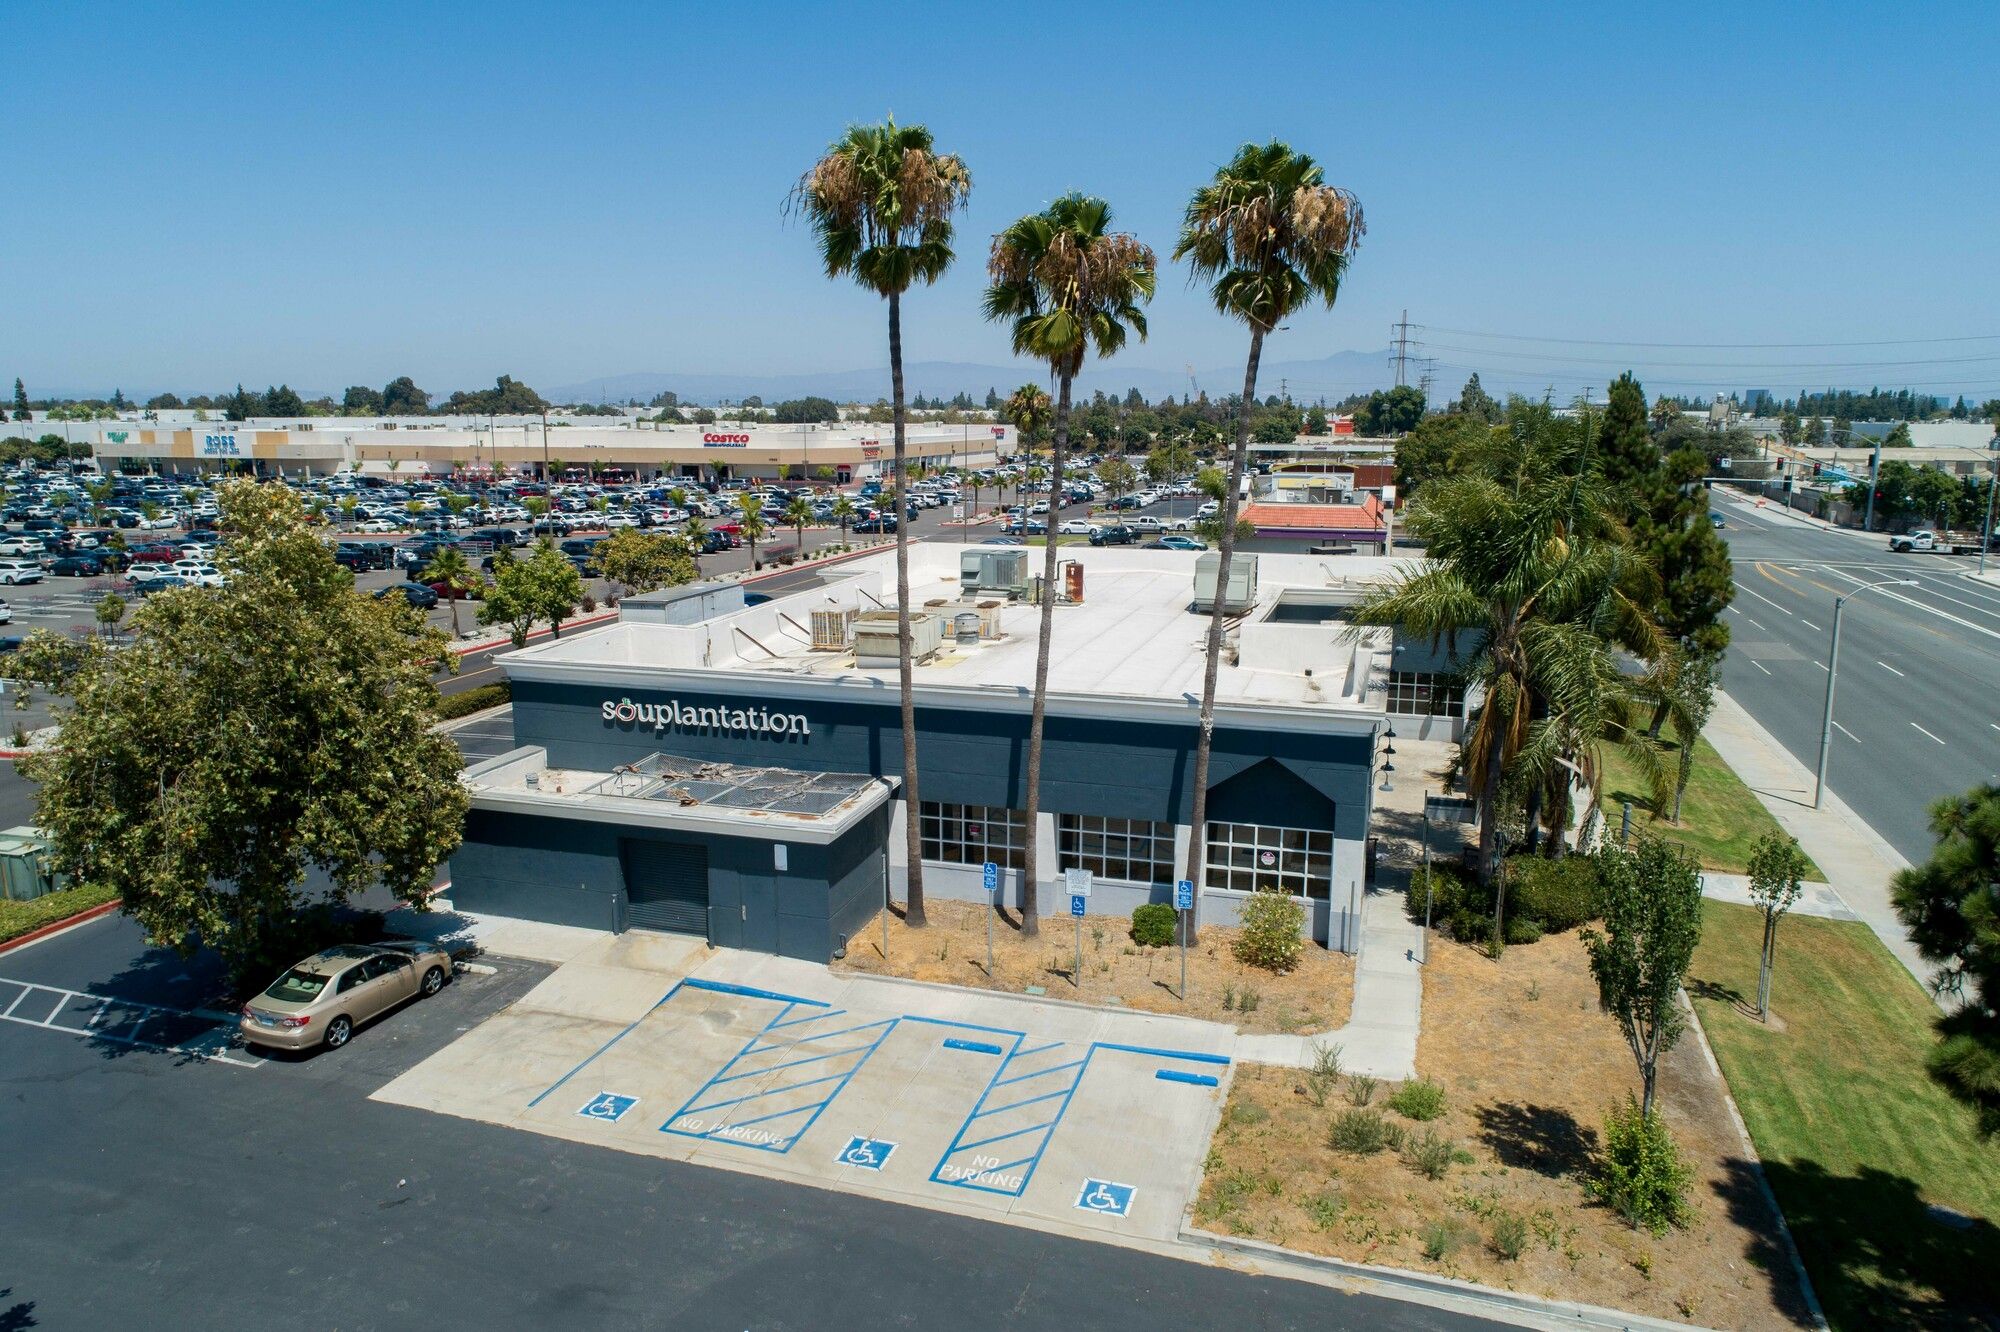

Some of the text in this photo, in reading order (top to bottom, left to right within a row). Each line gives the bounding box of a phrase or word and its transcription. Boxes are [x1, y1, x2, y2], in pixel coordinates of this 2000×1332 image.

[205, 435, 235, 447] ROSS
[704, 433, 749, 442] COSTCO
[602, 699, 811, 734] souplantation
[677, 1117, 704, 1130] NO
[972, 1155, 1000, 1169] NO
[938, 1164, 1023, 1188] PARKING
